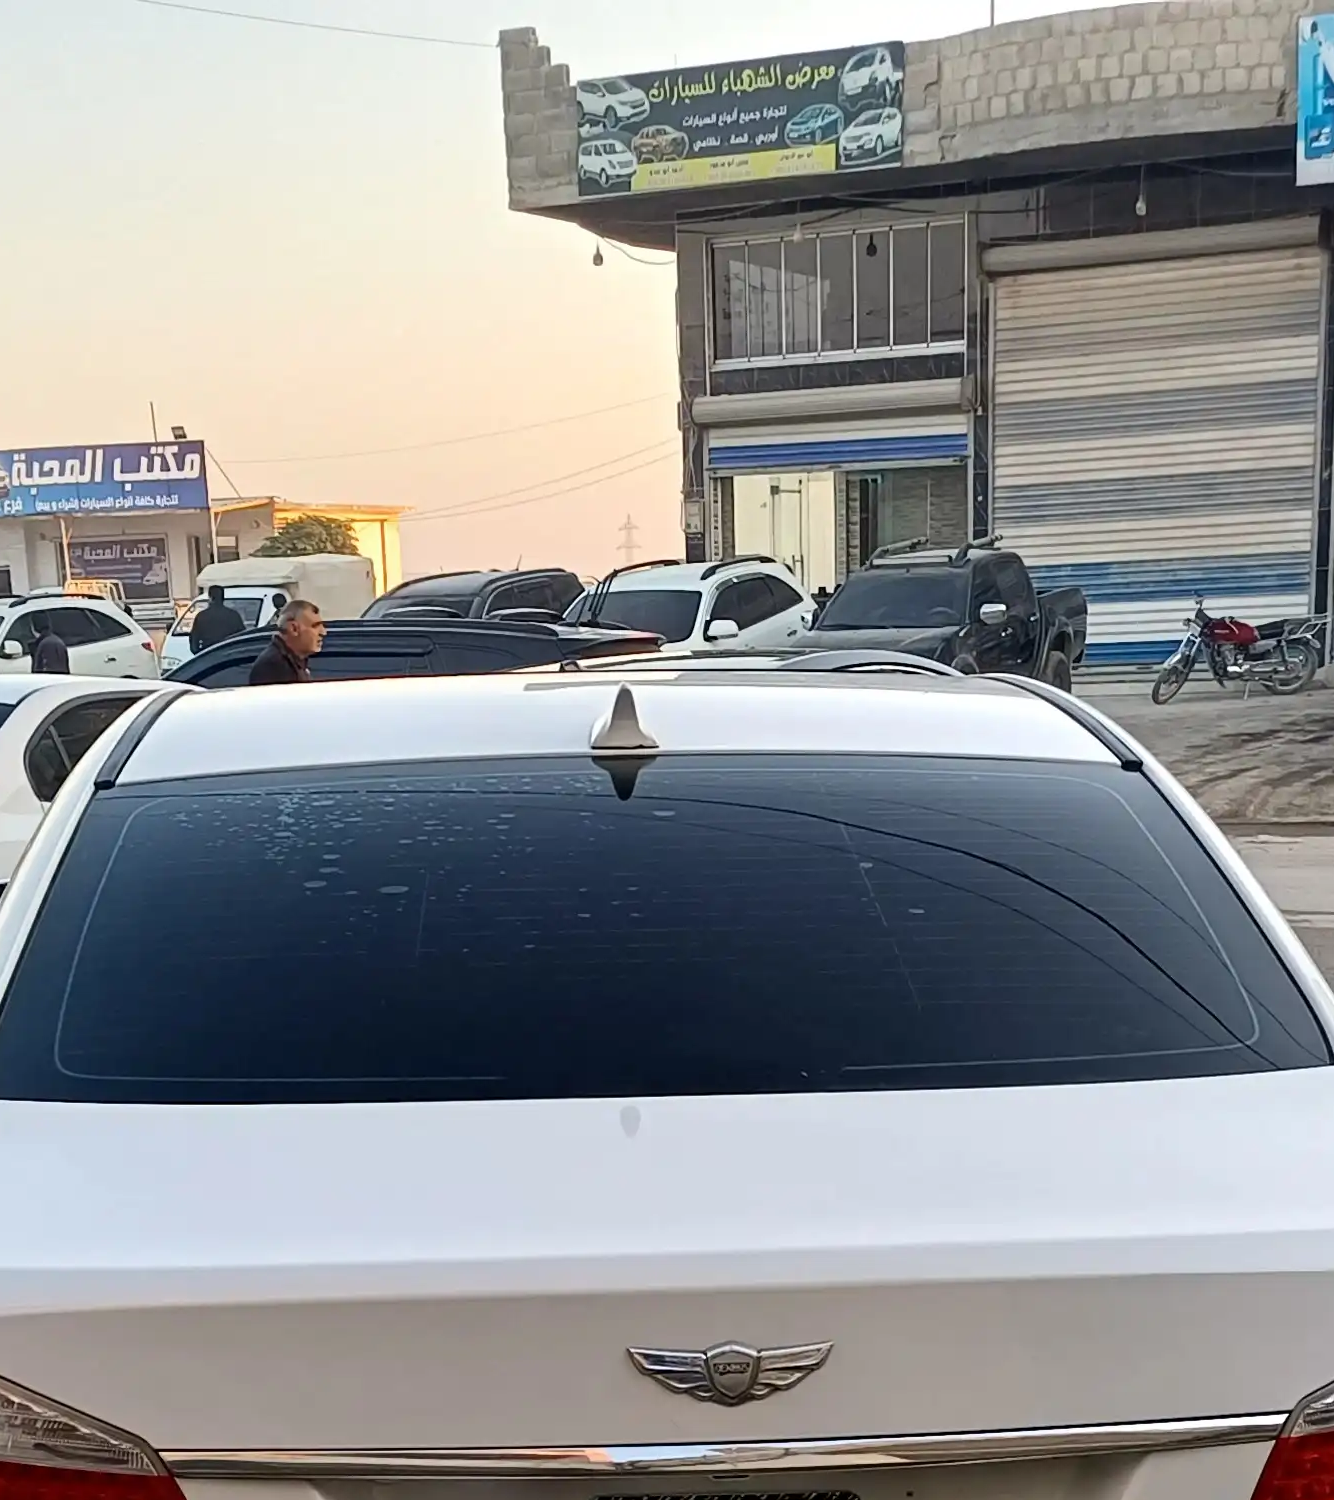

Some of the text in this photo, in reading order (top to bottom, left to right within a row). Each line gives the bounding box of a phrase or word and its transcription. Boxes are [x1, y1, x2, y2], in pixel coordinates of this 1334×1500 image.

[648, 61, 836, 106] معرض الشهباء للسيارات
[11, 446, 201, 495] مكتب المحبة
[4, 496, 23, 515] فرع
[83, 543, 158, 564] مكتب المحبة
